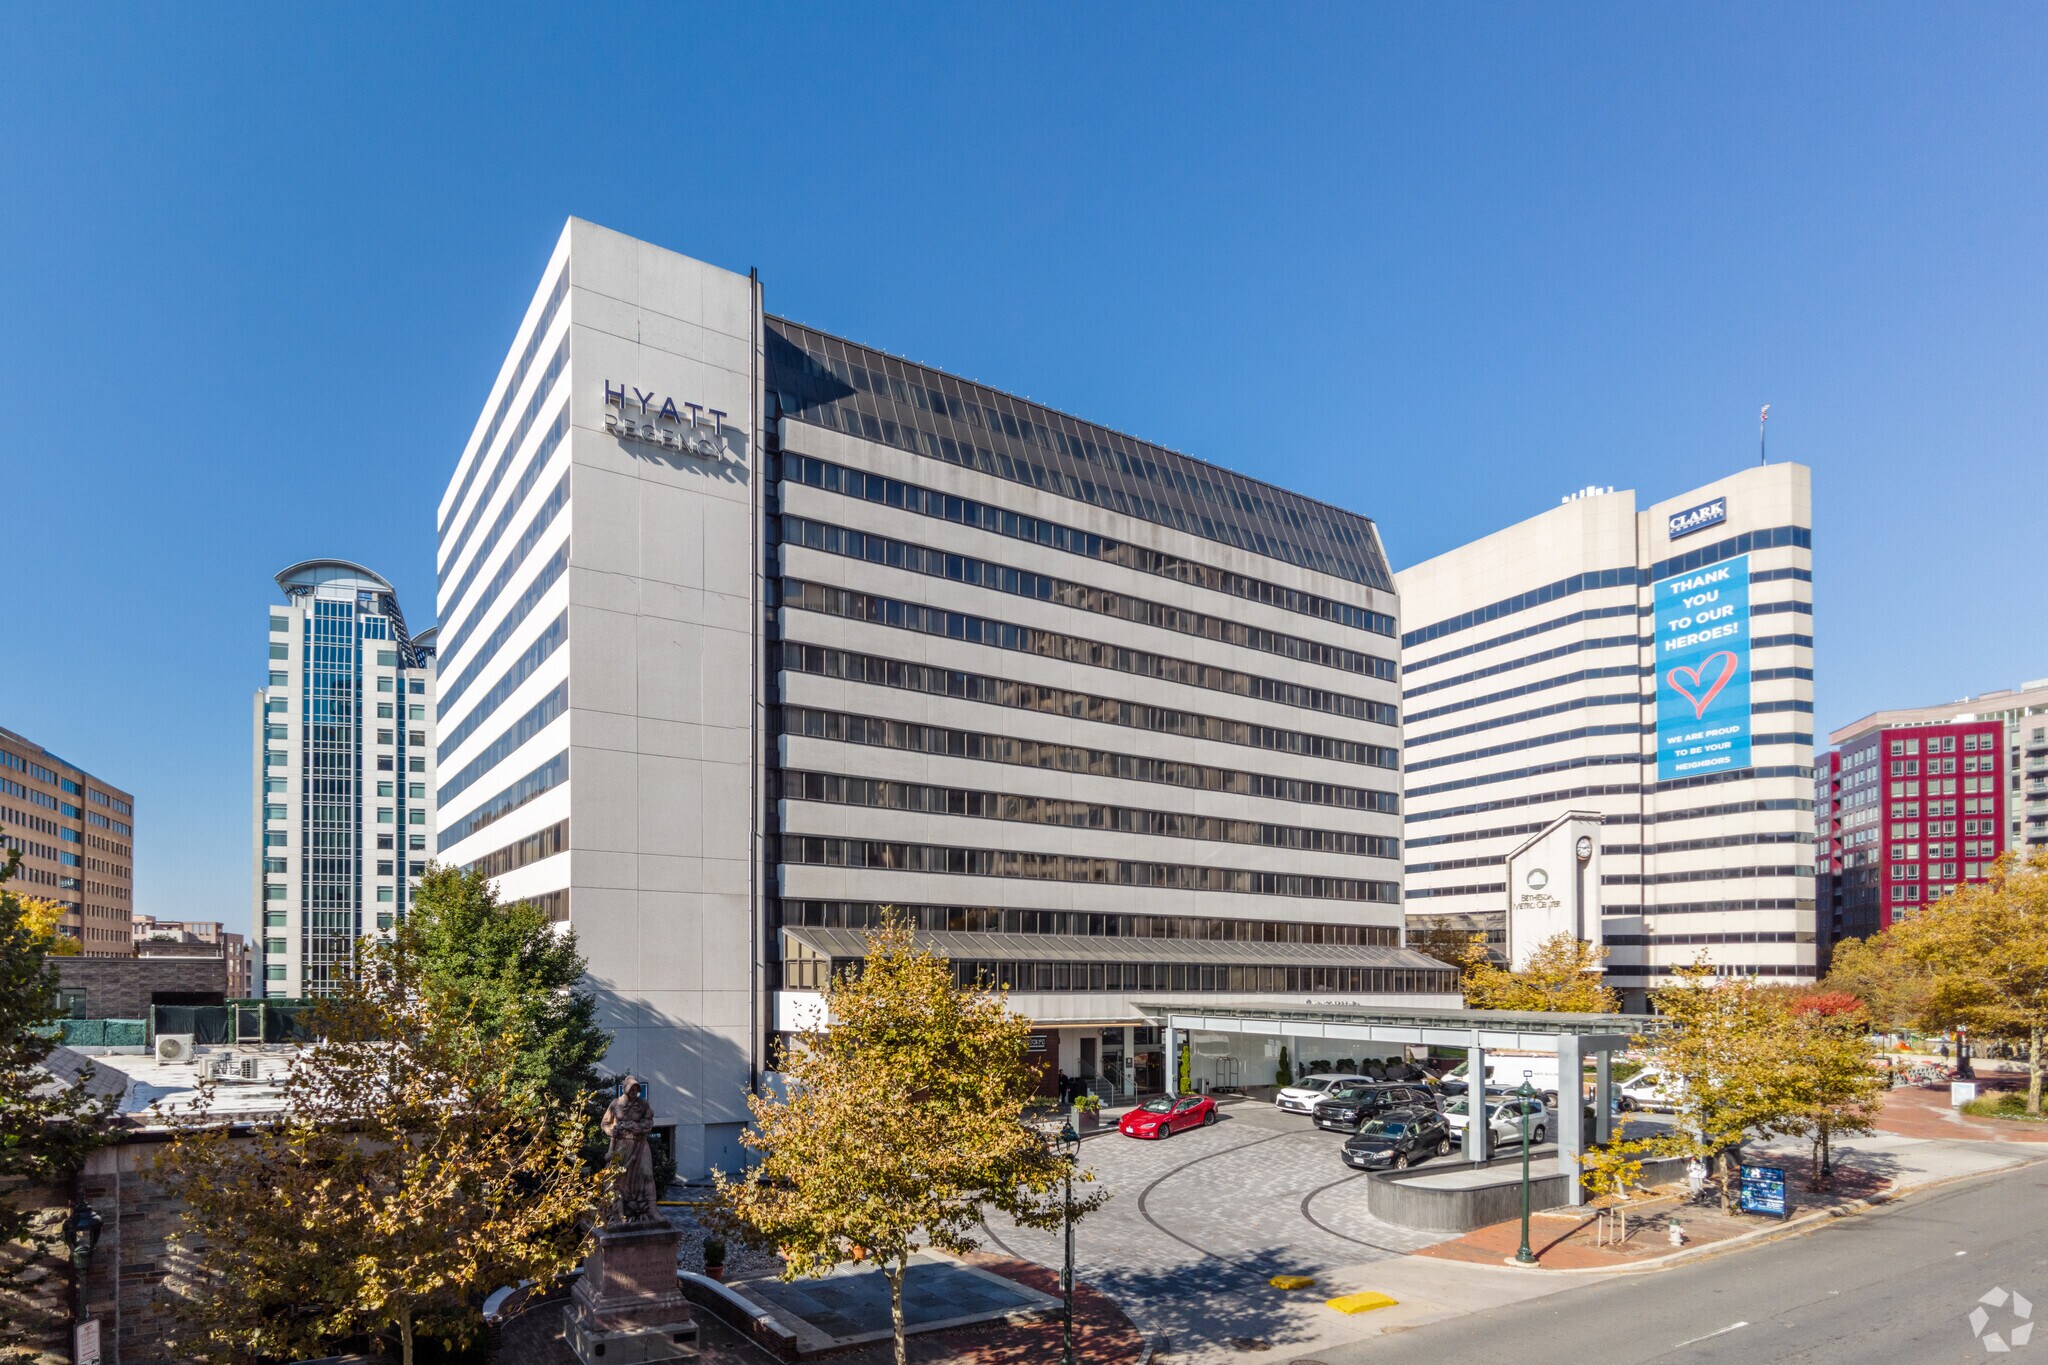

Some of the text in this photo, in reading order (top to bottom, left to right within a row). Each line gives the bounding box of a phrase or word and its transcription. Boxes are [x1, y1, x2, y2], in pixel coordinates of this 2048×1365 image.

[605, 379, 727, 436] HYATT
[603, 413, 728, 461] REGENCY
[1669, 502, 1723, 528] CLARK
[1670, 567, 1729, 594] THANK
[1683, 590, 1719, 609] YOU
[1668, 604, 1734, 632] TO OUR
[1665, 622, 1738, 652] HEROES!
[1667, 726, 1739, 744] WE ARE PROUD
[1675, 742, 1731, 757] TO BE YOUR
[1675, 757, 1731, 770] NEIGHBORS
[1537, 900, 1561, 909] CETER
